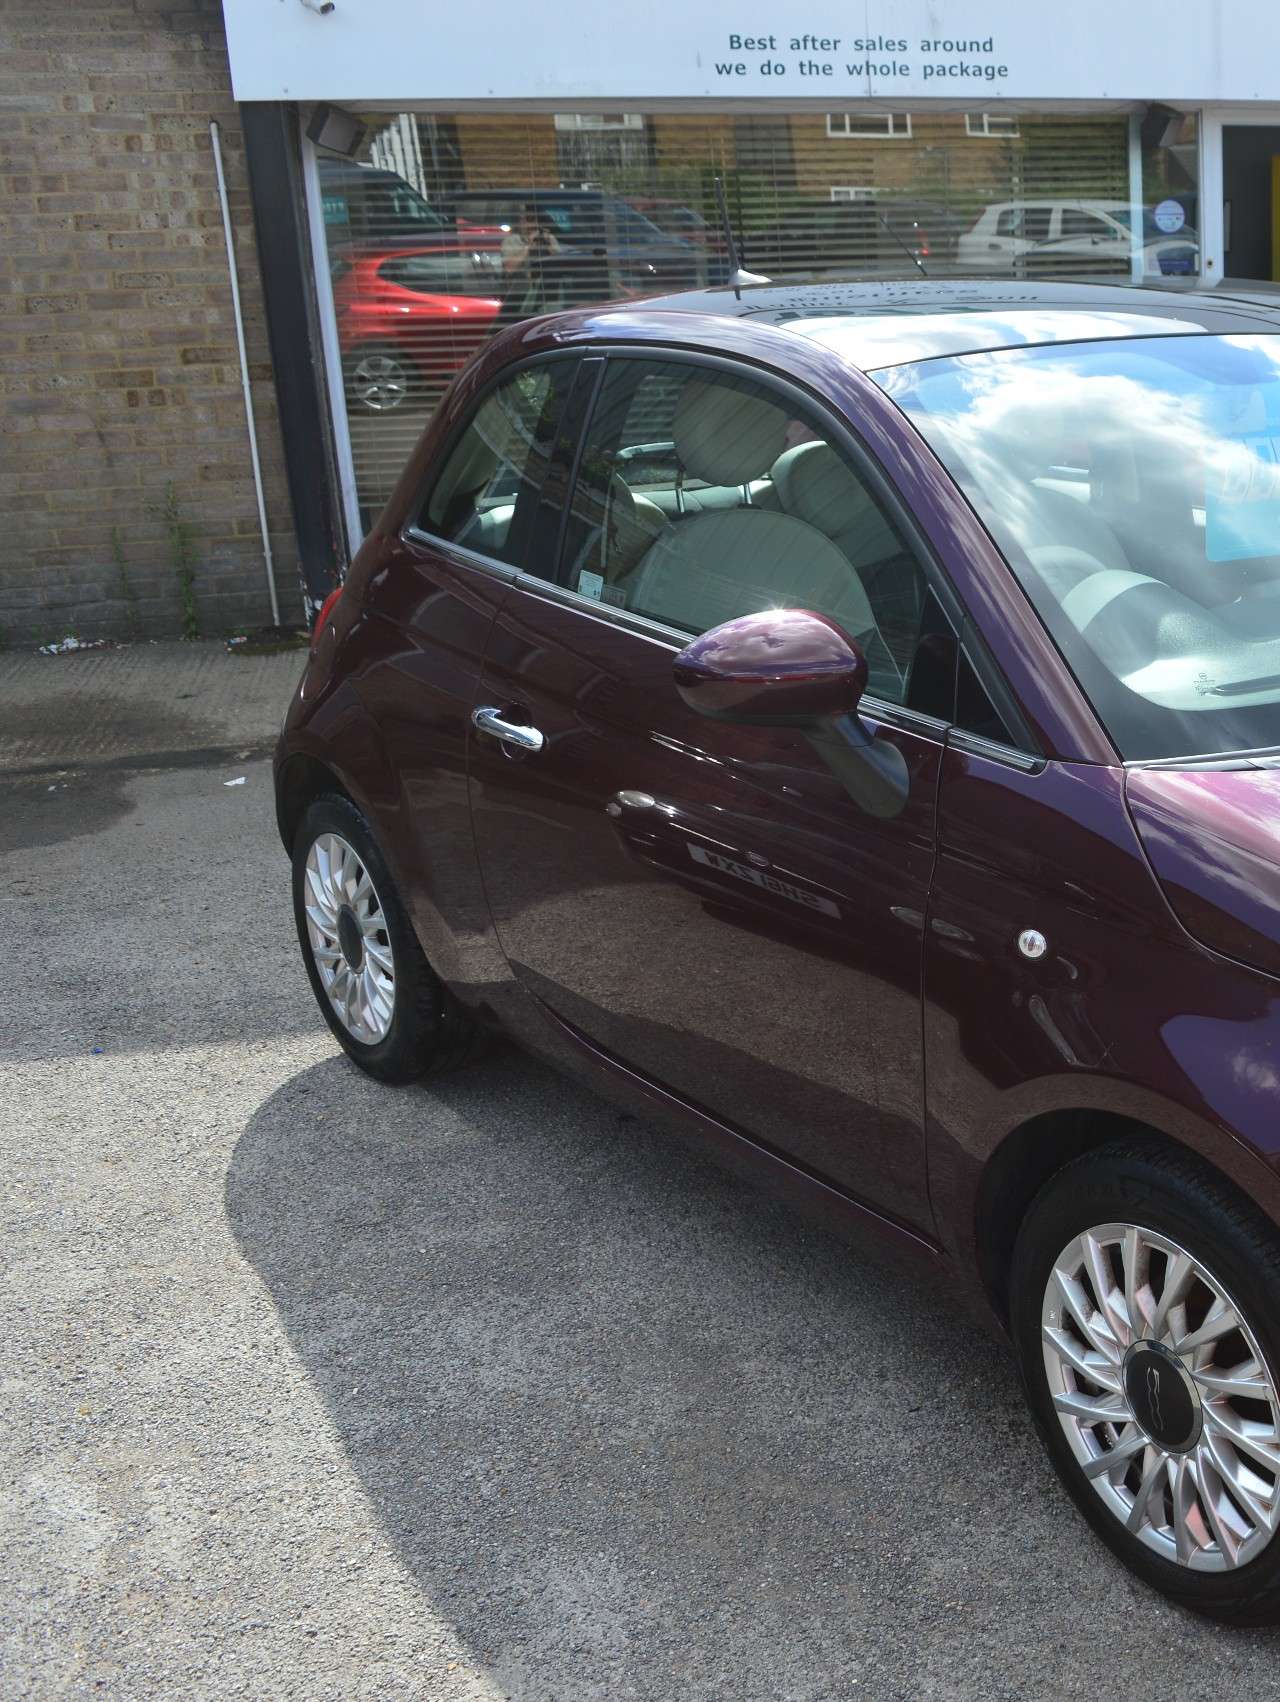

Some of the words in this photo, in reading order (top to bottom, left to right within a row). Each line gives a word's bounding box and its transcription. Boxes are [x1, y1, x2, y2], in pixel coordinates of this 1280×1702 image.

[729, 34, 776, 50] Best
[790, 35, 841, 51] after
[854, 36, 908, 51] sales
[920, 37, 993, 52] around
[715, 63, 747, 75] we
[760, 60, 786, 75] do
[799, 60, 833, 76] the
[846, 61, 910, 76] whole
[923, 61, 1009, 80] package
